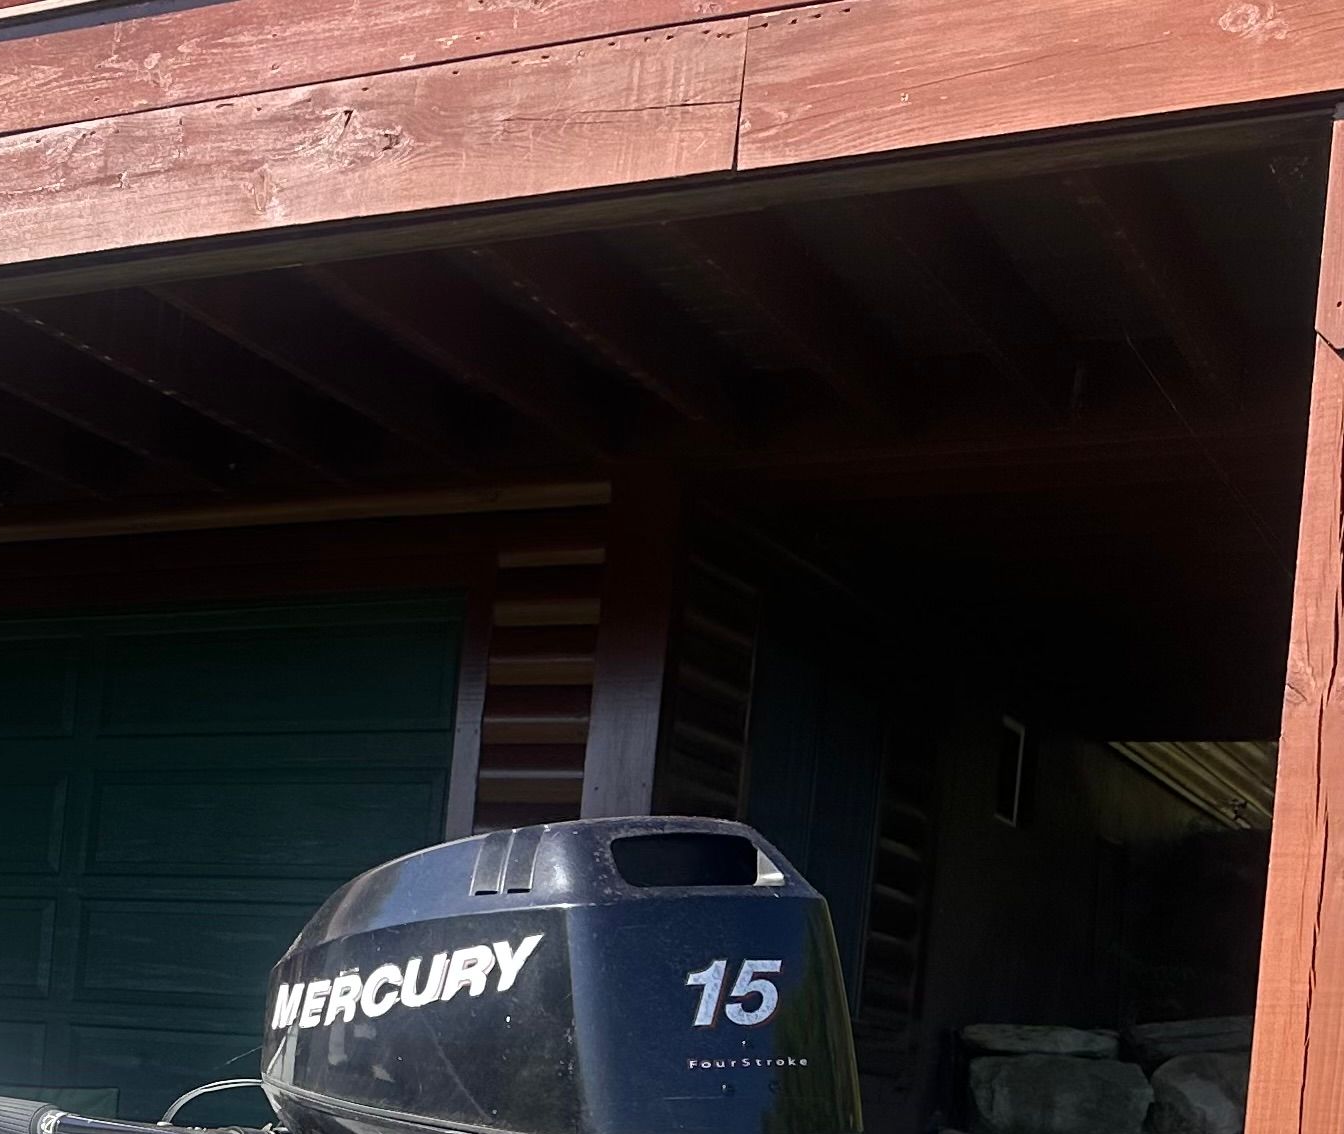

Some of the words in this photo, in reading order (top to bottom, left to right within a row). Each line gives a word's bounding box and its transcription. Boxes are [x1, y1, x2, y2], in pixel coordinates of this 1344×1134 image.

[271, 933, 544, 1030] MERCURY
[686, 959, 782, 1027] 15
[688, 1056, 809, 1069] FourStroke
